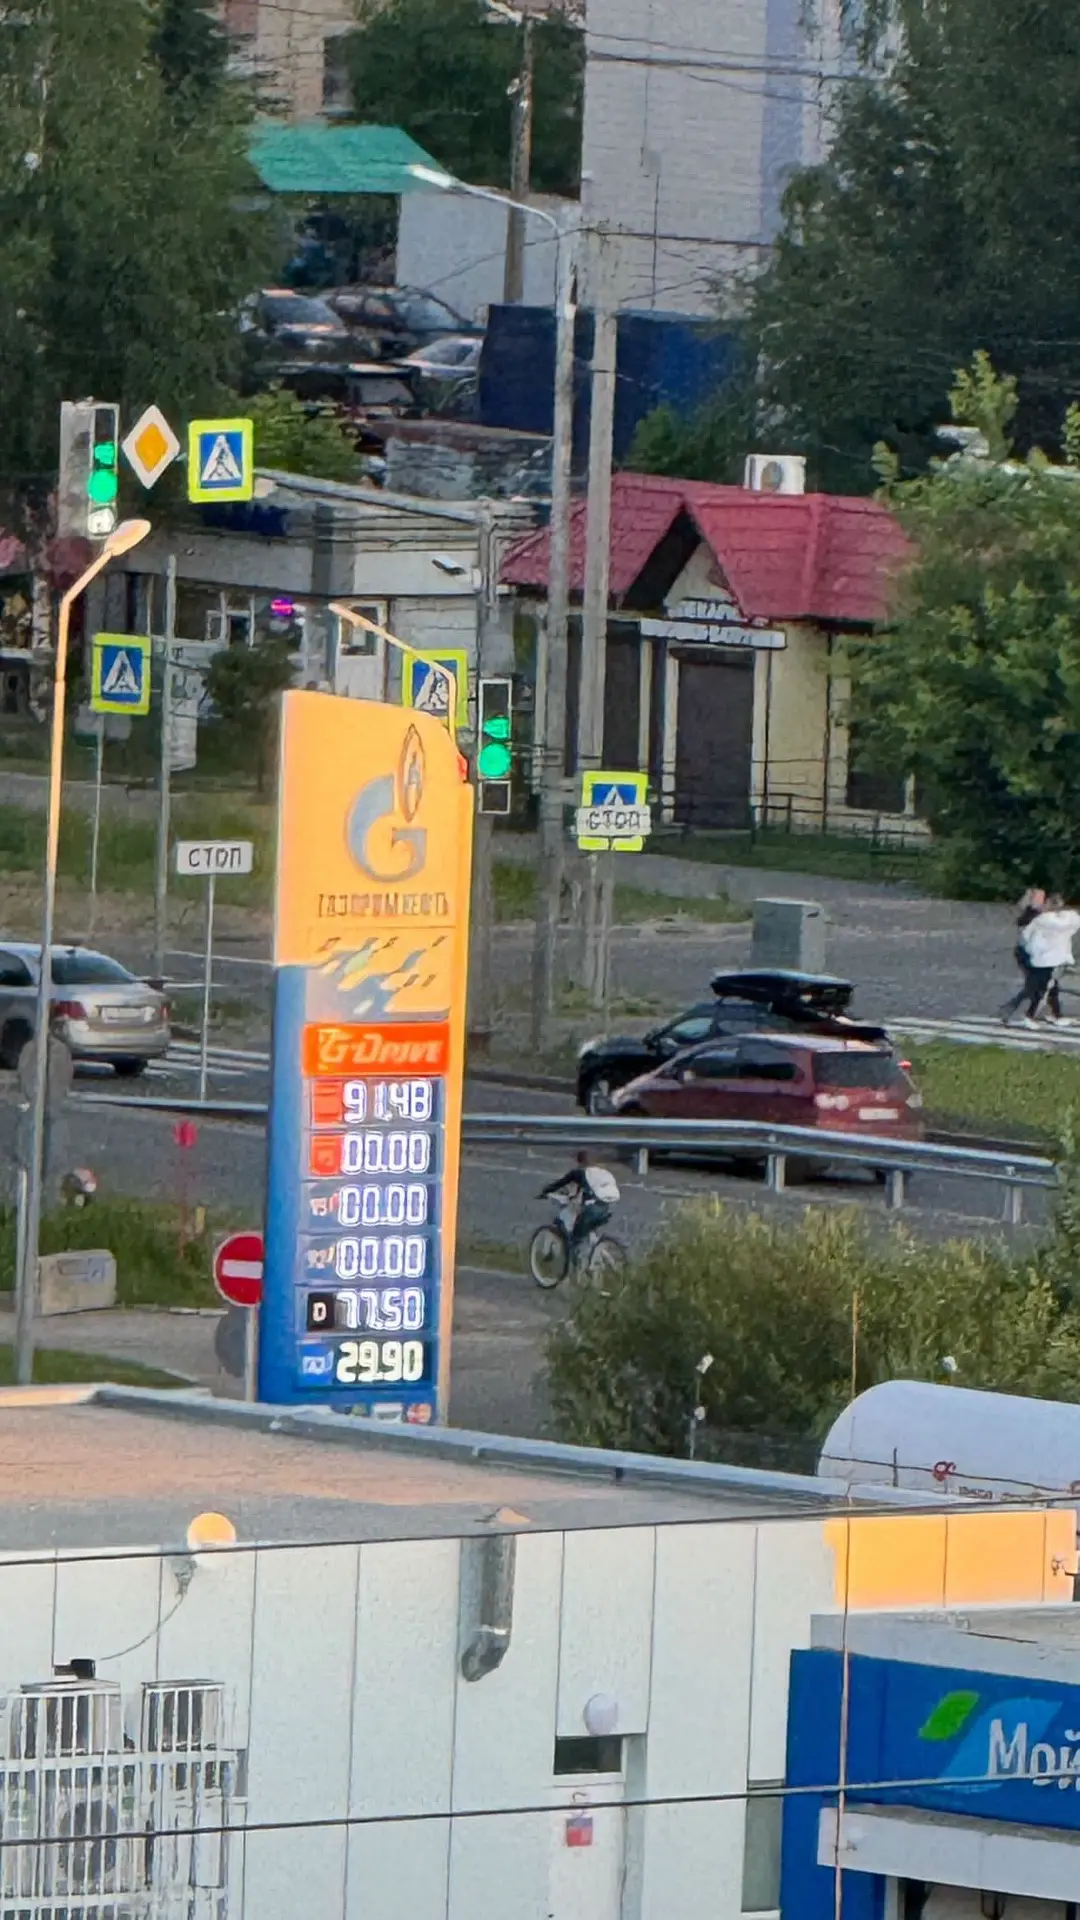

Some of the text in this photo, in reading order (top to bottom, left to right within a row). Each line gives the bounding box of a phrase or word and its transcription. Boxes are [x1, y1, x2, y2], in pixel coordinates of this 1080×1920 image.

[188, 847, 242, 869] СТОП
[341, 1130, 430, 1174] 00.00
[338, 1184, 428, 1226] 00.00
[336, 1235, 426, 1279] 00.00
[336, 1340, 423, 1383] 29.90
